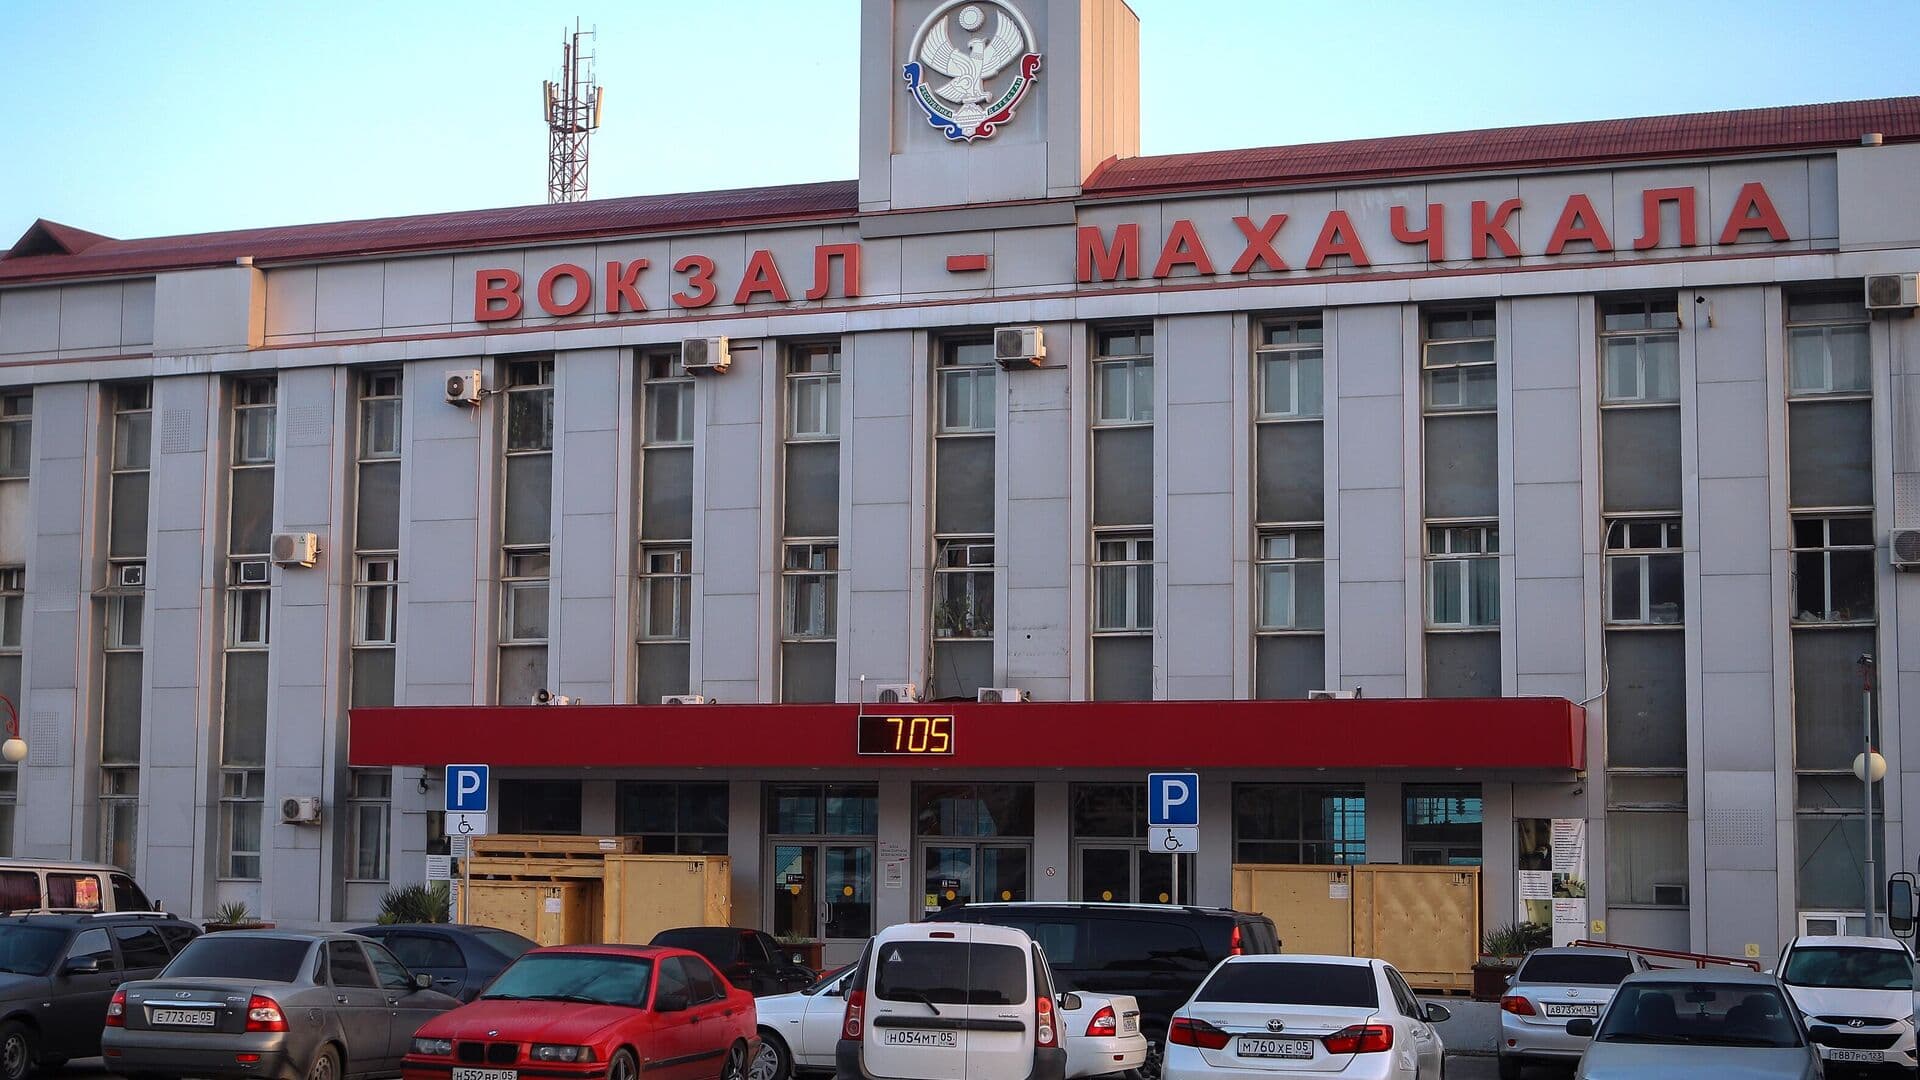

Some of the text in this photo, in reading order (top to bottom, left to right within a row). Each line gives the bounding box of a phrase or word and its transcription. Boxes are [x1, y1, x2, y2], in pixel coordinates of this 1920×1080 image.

[474, 243, 862, 323] ВОКЗАЛ
[1077, 181, 1793, 284] МАХАЧКАЛА
[457, 770, 480, 806] P
[1162, 779, 1189, 820] P
[200, 1011, 212, 1021] 05
[889, 1031, 953, 1045] Н054МТ 05
[1242, 1040, 1309, 1054] М760ХЕ 05
